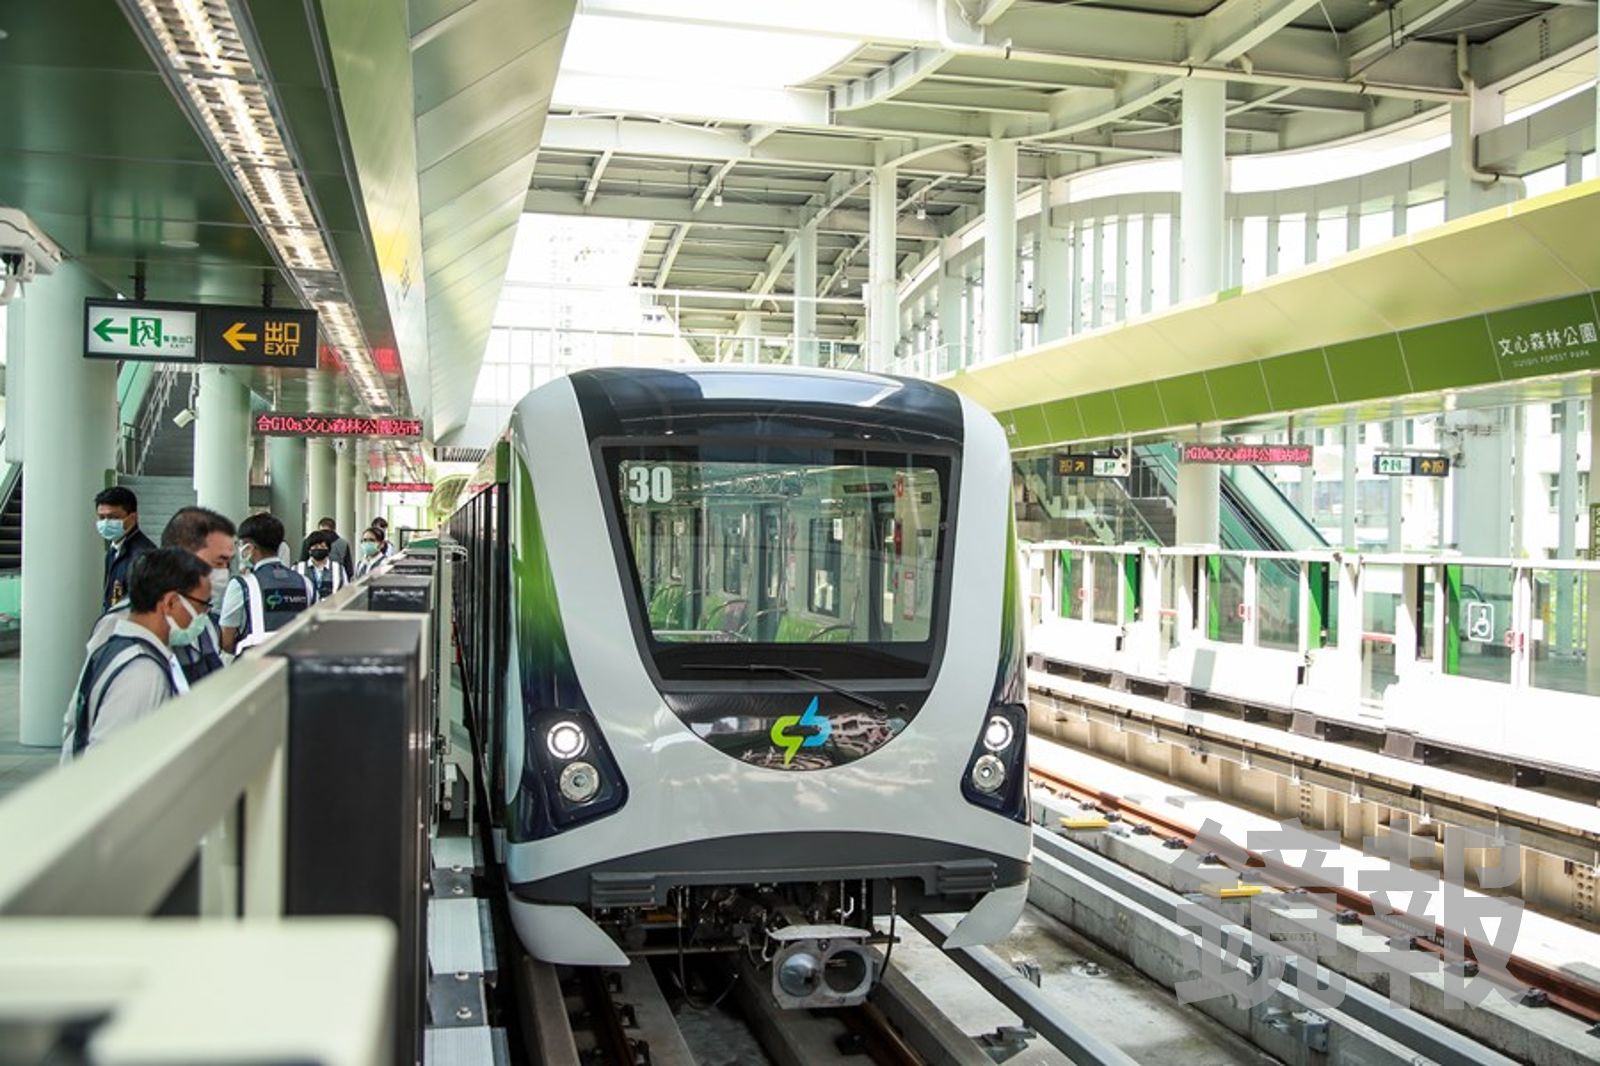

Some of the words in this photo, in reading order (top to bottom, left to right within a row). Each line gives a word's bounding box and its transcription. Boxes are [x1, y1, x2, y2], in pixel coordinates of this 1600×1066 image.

[264, 320, 300, 342] 出口
[1498, 322, 1598, 357] 文心森林公園
[264, 342, 300, 356] EXIT
[628, 466, 672, 503] 30
